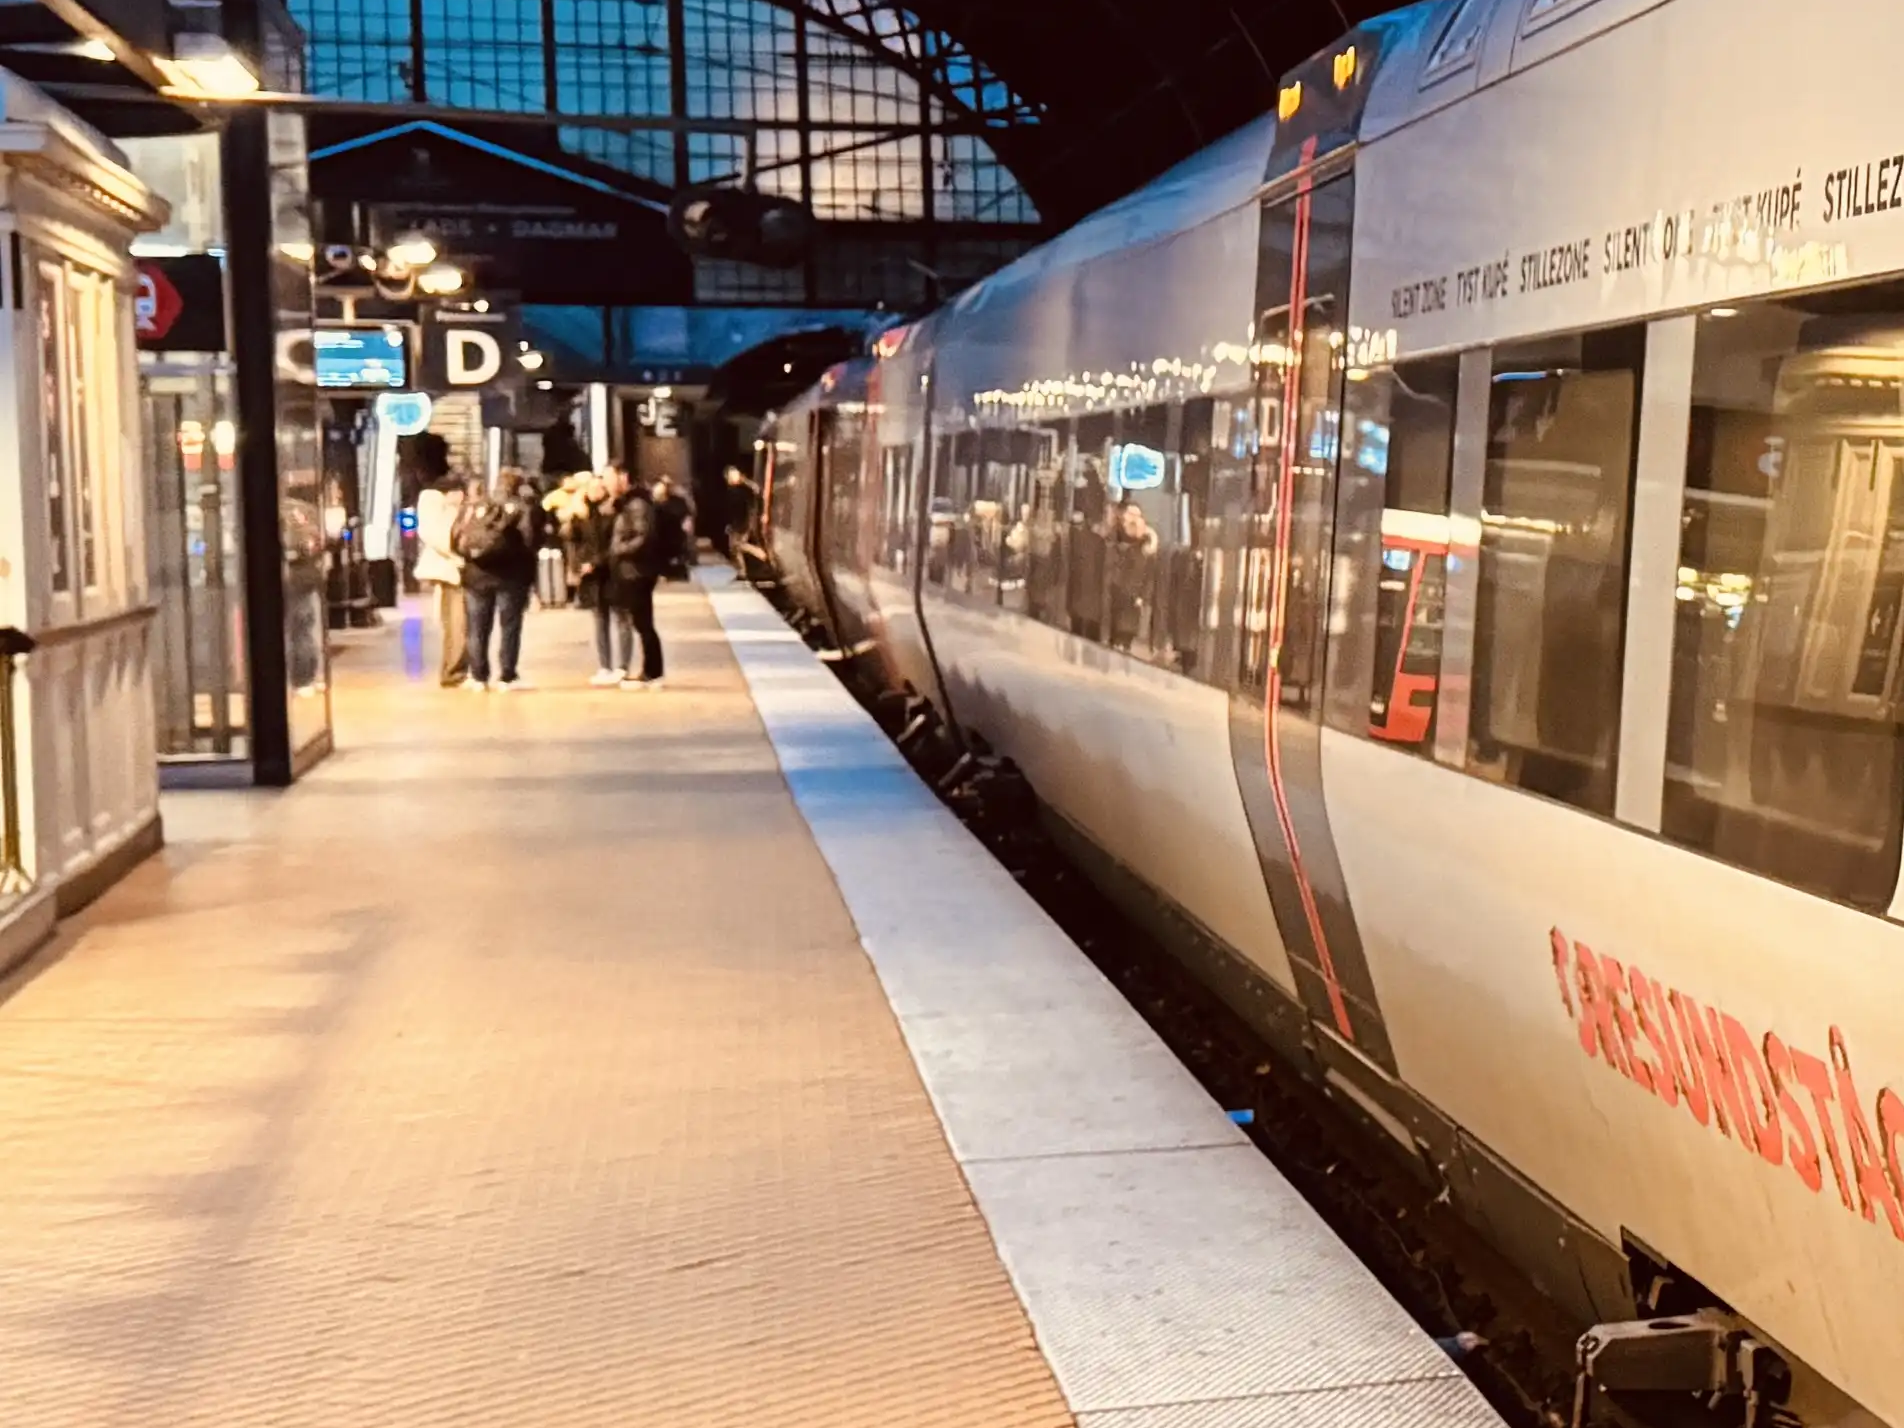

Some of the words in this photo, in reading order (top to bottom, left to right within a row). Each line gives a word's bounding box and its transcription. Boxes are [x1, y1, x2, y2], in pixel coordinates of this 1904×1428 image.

[1456, 266, 1482, 308] TYST
[1519, 237, 1591, 293] STILLEZONE
[1603, 221, 1651, 275] SILENT
[445, 328, 502, 385] D
